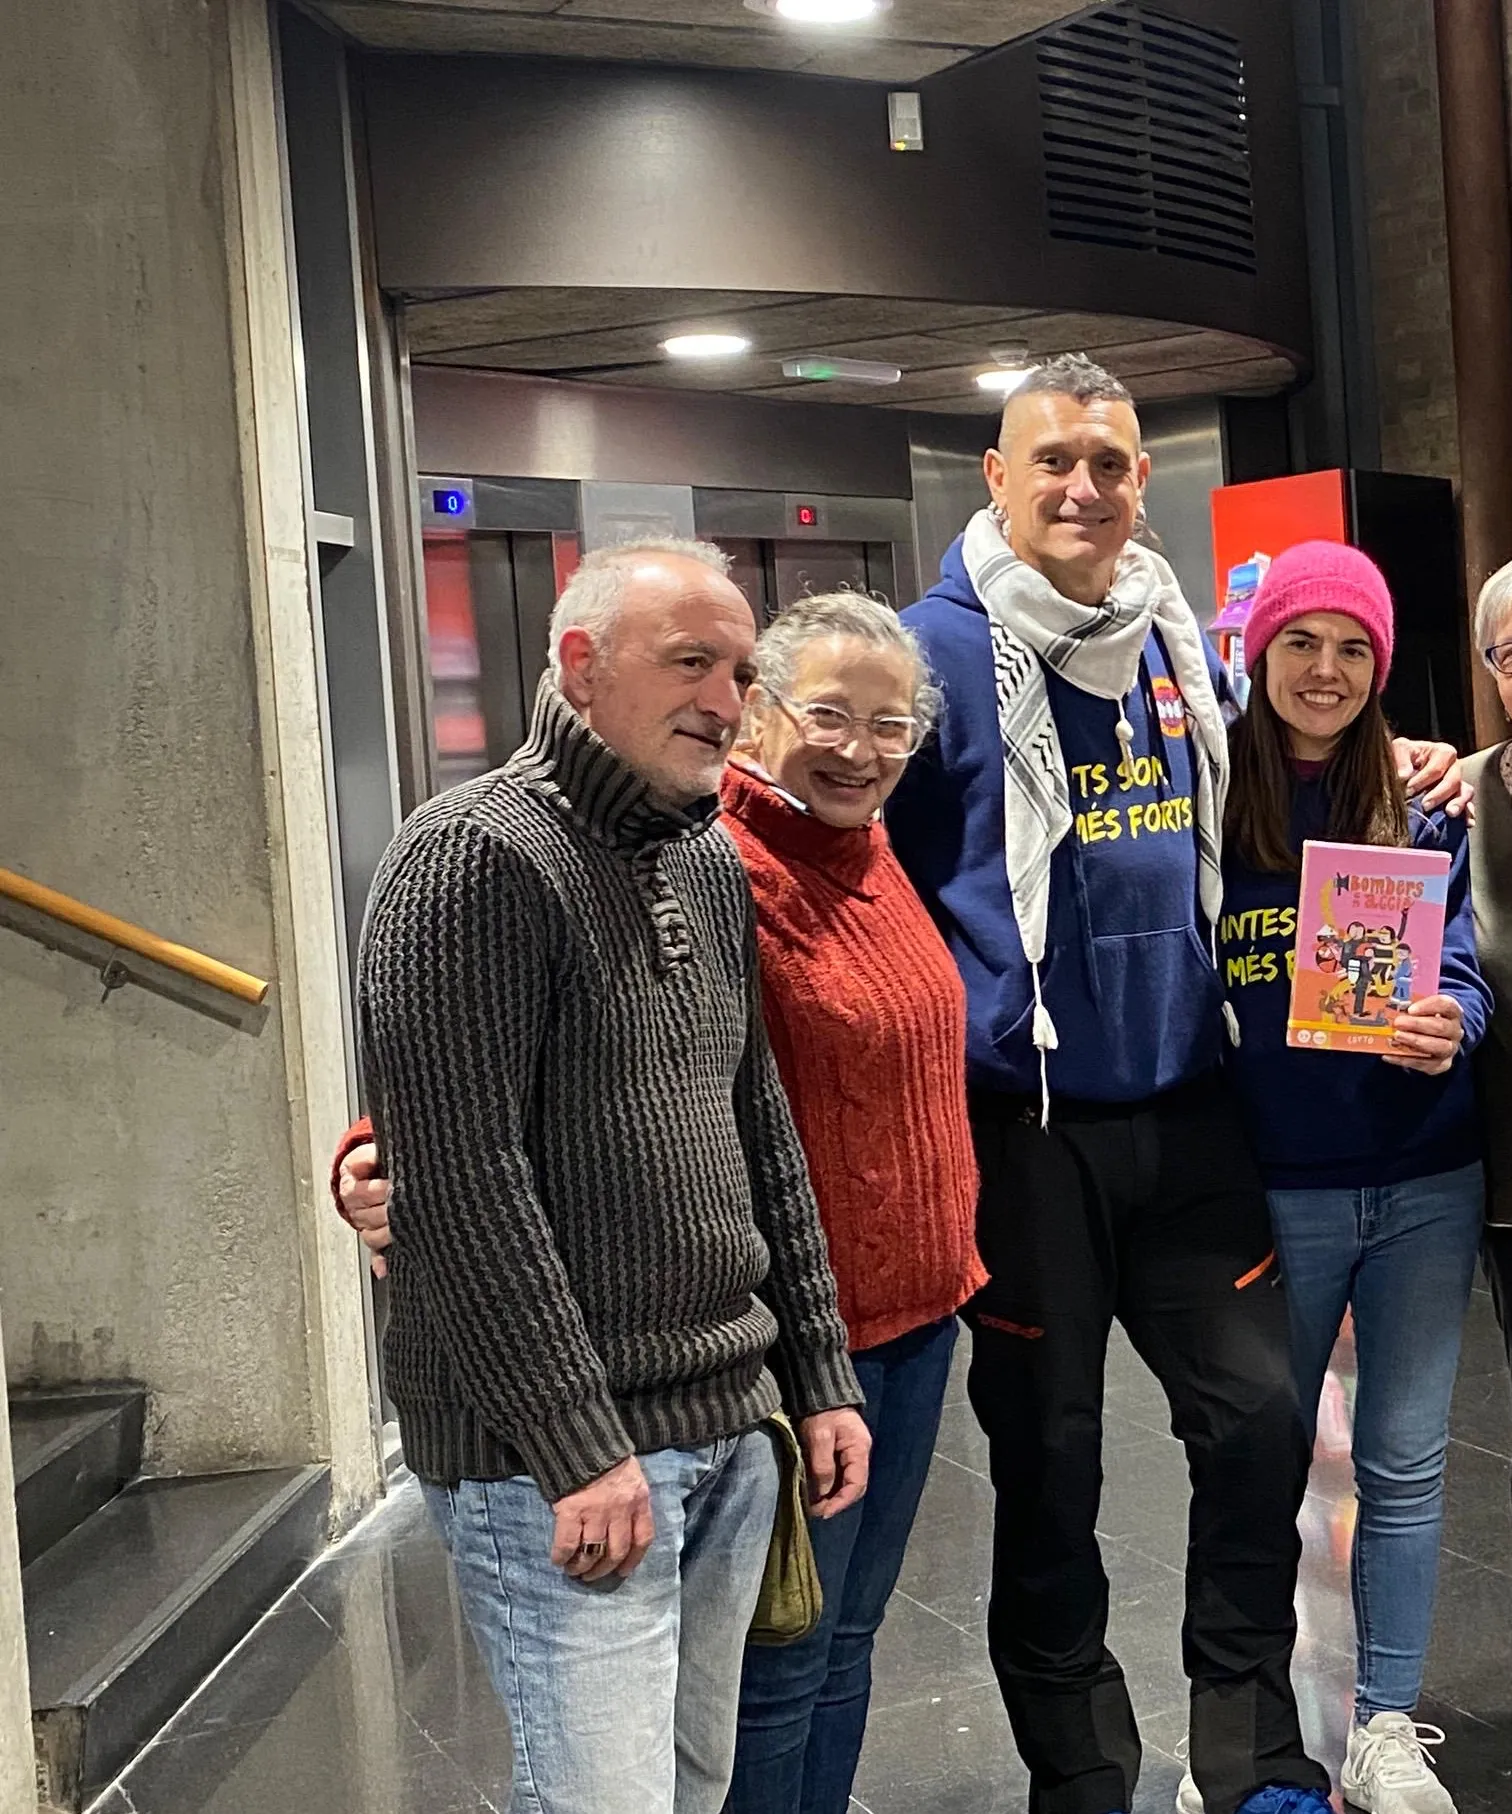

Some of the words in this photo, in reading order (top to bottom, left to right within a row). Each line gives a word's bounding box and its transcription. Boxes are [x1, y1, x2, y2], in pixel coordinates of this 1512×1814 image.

[448, 496, 458, 511] 0
[1127, 796, 1193, 840] FORTS
[1227, 945, 1279, 988] MÉS
